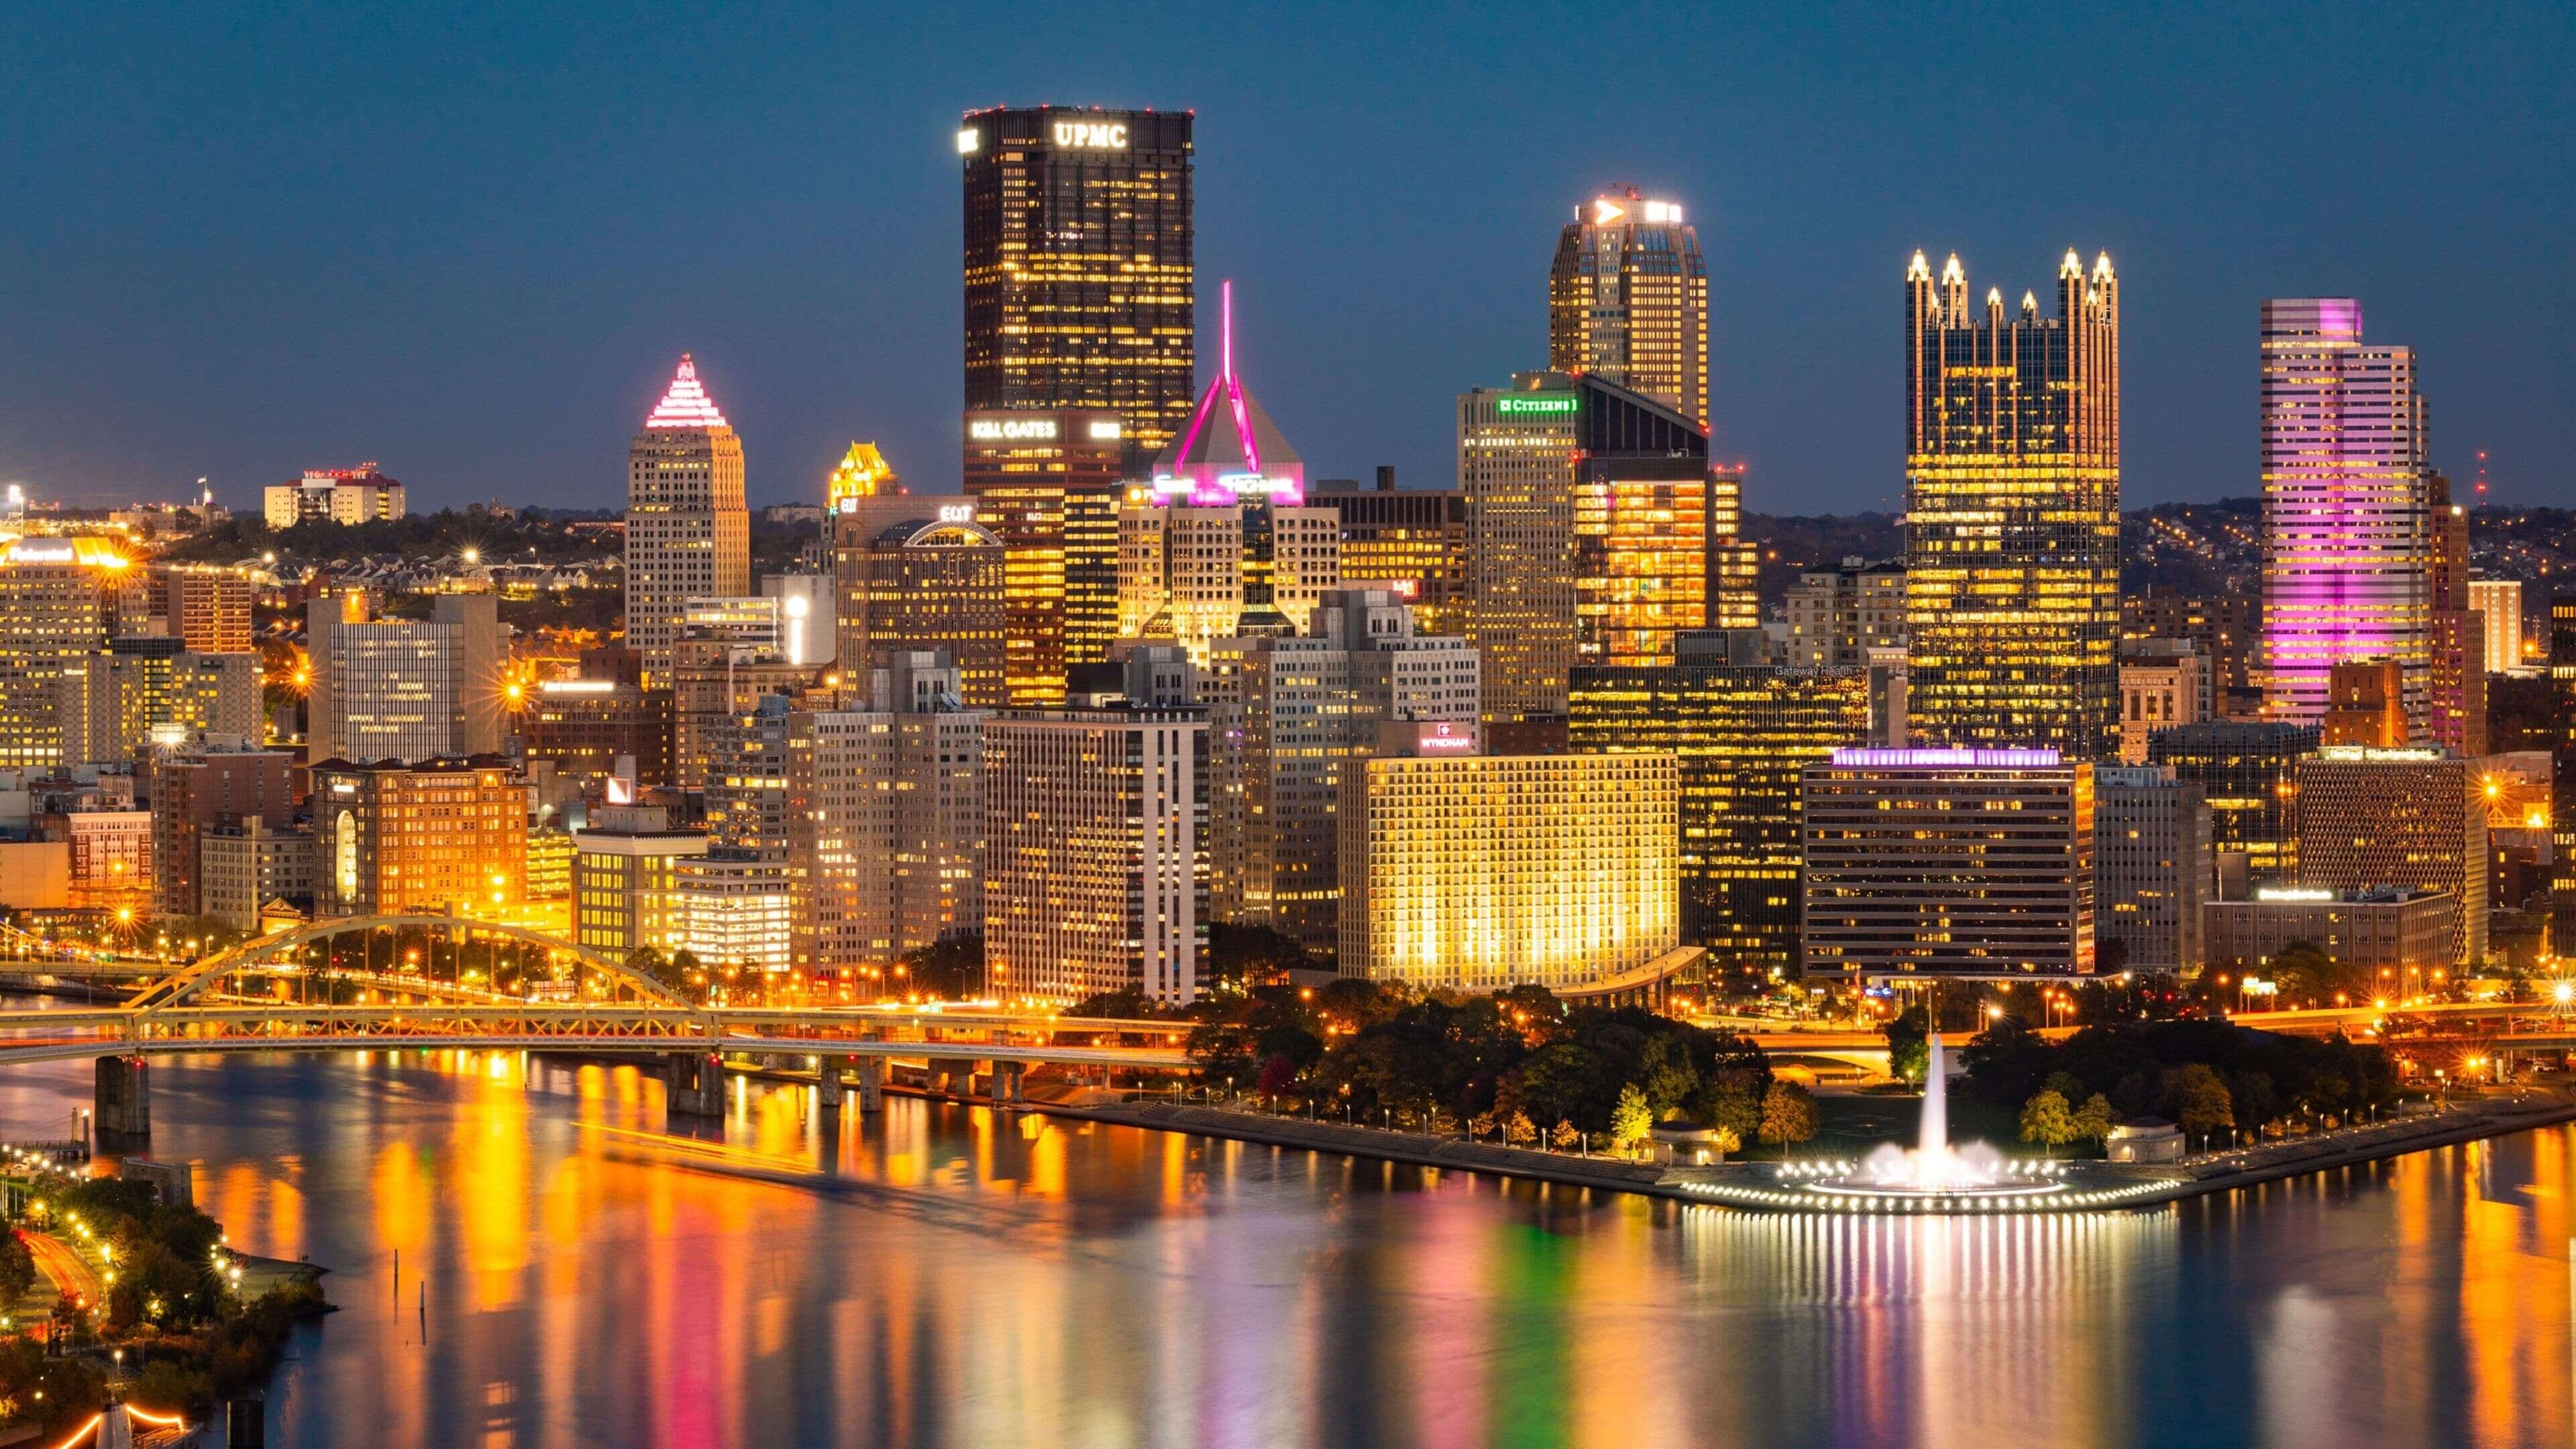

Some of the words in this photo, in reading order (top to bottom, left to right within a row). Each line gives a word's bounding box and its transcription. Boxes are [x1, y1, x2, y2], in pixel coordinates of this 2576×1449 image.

[1054, 123, 1127, 148] UPMC
[1004, 421, 1056, 438] GATES
[940, 506, 972, 521] EQT
[1775, 665, 1819, 678] Gateway
[1821, 665, 1852, 675] Health
[1421, 738, 1468, 747] WYNDHAM
